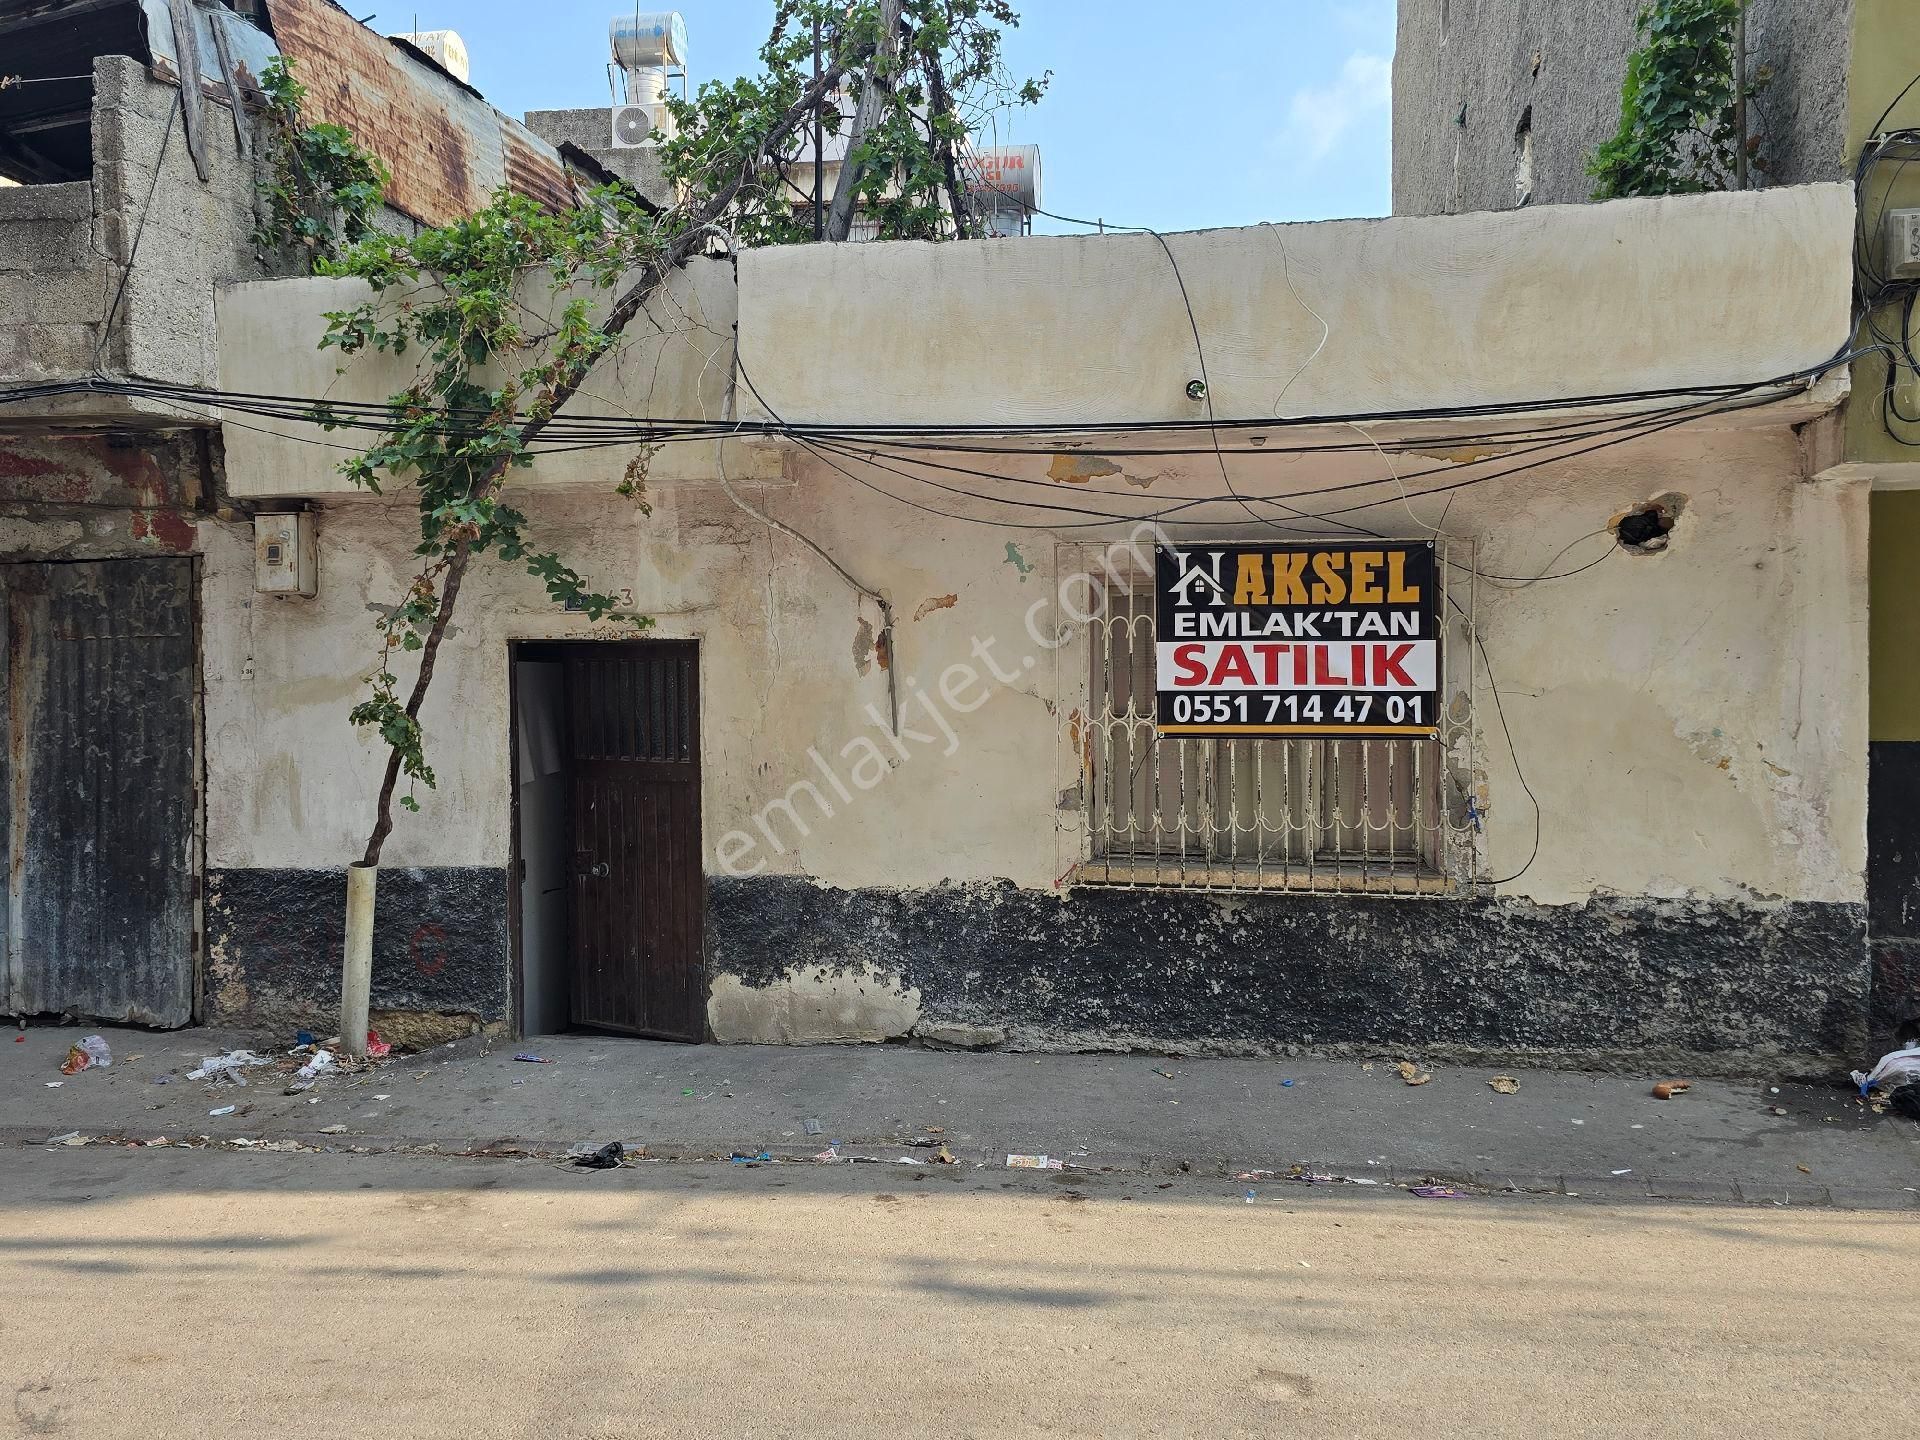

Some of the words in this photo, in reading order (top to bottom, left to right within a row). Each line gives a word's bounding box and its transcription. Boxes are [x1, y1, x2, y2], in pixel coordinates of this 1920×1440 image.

[1233, 551, 1420, 605] AKSEL
[1174, 611, 1420, 637] EMLAK'TAN
[1173, 643, 1418, 687] SATILIK
[1173, 694, 1249, 723] 0551
[1262, 695, 1323, 723] 714
[1333, 695, 1373, 723] 47
[1386, 695, 1422, 724] 01
